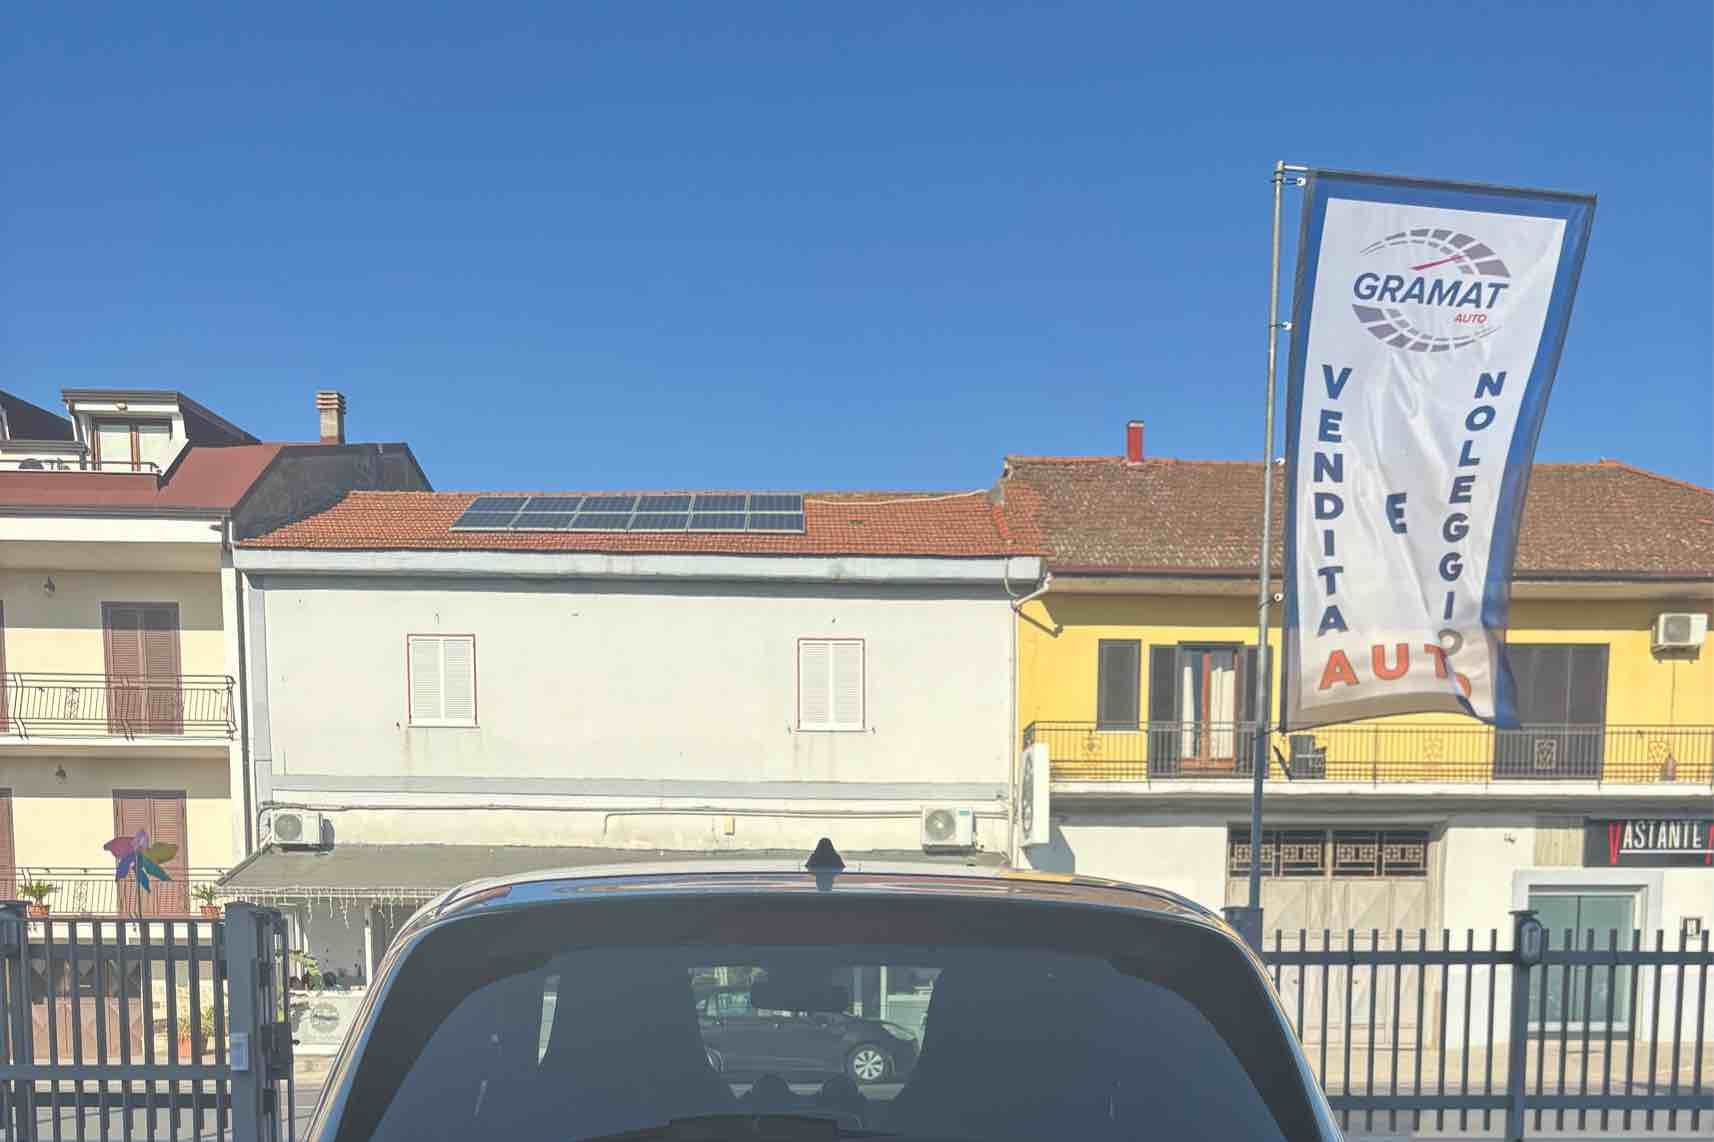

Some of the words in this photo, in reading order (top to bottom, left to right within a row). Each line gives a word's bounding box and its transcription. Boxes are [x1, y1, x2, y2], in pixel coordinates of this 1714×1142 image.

[1353, 272, 1510, 309] GRAMAT
[1455, 312, 1488, 324] AUTO
[1313, 364, 1353, 638] VENDITA
[1385, 492, 1408, 535] E
[1436, 370, 1507, 657] NOLEGGIO
[1607, 820, 1703, 865] VASTANTE
